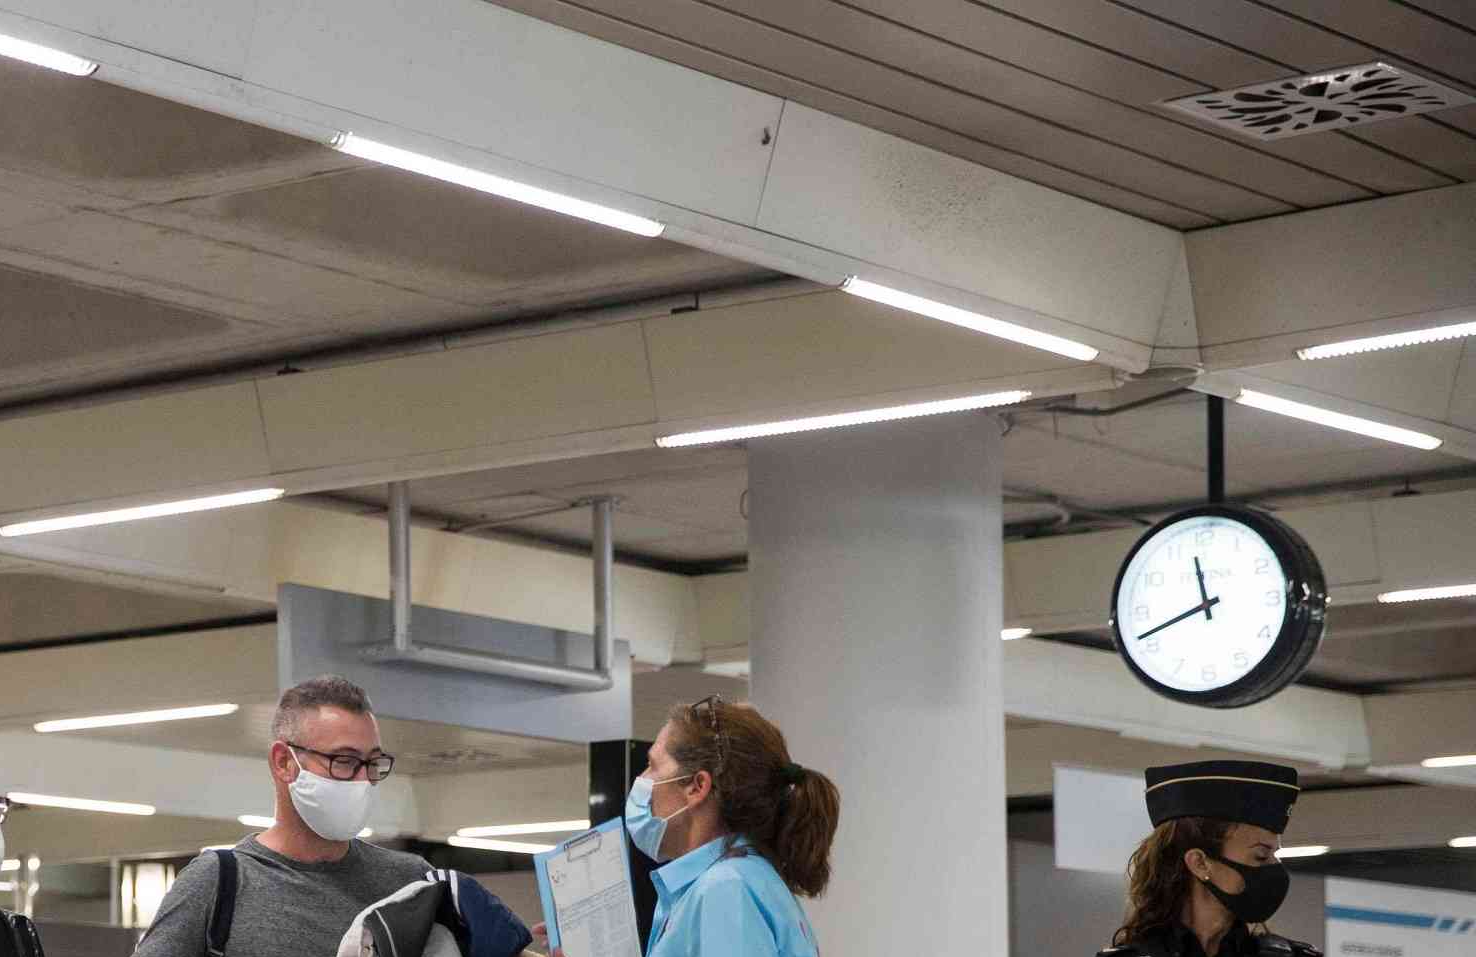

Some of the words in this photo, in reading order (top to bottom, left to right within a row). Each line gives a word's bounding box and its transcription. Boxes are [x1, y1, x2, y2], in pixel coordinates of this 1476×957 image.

[1254, 558, 1269, 575] 2
[1144, 571, 1164, 586] 10
[1265, 590, 1281, 607] 3
[1257, 625, 1272, 639] 4
[1233, 652, 1249, 669] 5
[1201, 665, 1217, 682] 6
